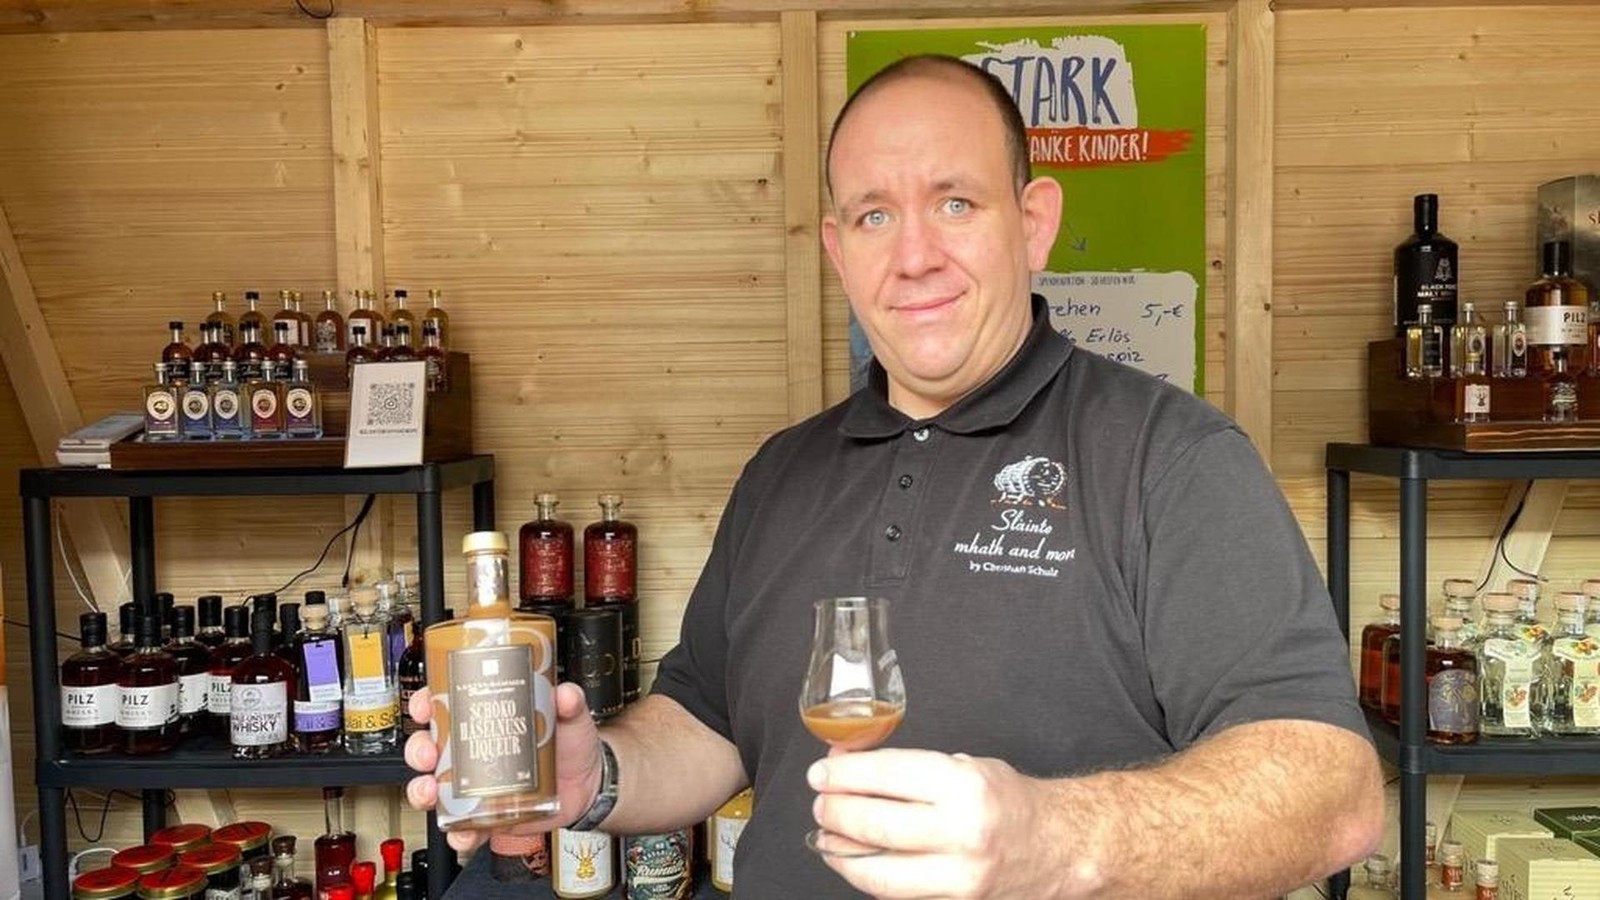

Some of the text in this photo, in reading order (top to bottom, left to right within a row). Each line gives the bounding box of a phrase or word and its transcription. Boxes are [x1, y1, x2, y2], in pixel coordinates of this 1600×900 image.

[1079, 132, 1149, 162] KINDER!
[954, 532, 1005, 556] mhath
[1008, 537, 1046, 560] and
[970, 560, 981, 573] by
[67, 693, 94, 705] PILZ
[122, 694, 149, 706] PILZ
[469, 699, 517, 719] SCHOKO
[460, 715, 528, 742] HASELNUSS
[469, 736, 521, 763] LIQUEUR
